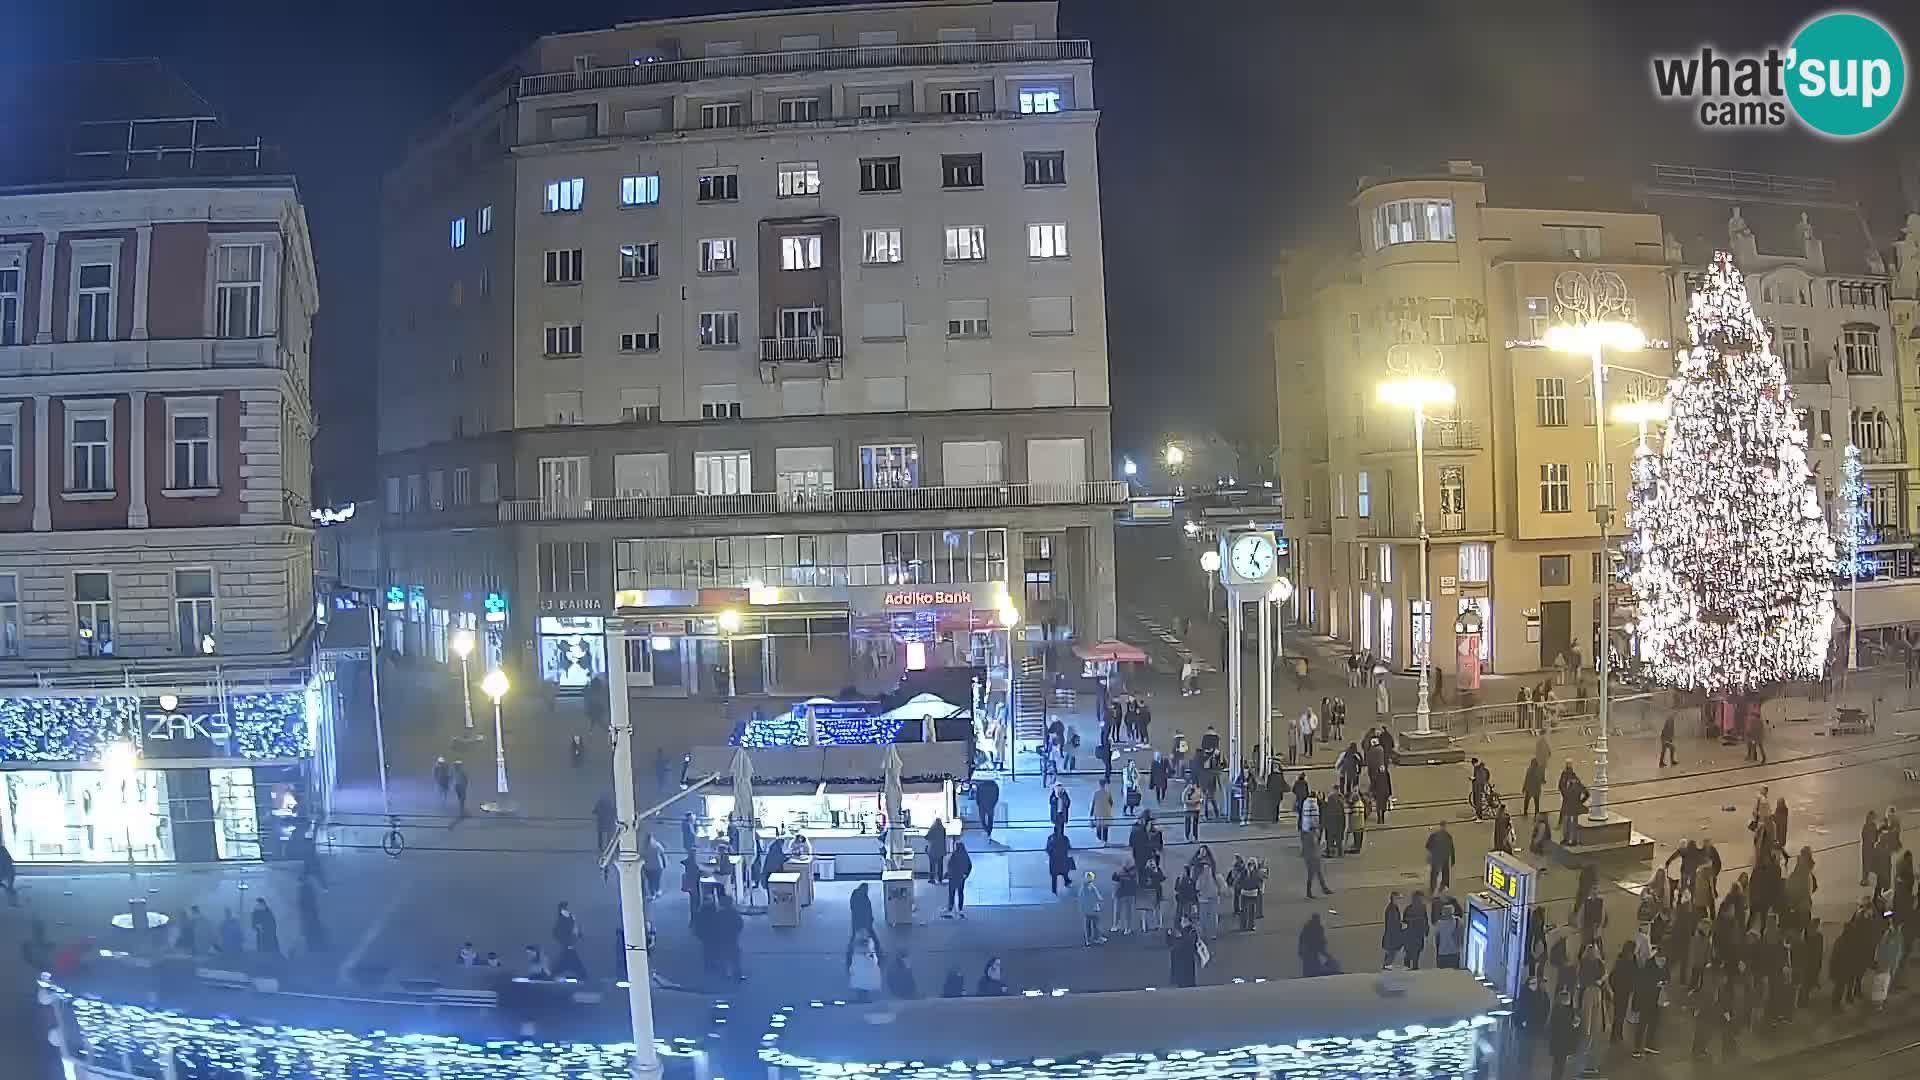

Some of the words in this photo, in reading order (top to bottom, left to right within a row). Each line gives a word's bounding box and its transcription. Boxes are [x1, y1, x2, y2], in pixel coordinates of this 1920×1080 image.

[885, 591, 933, 605] Addiko
[935, 590, 971, 604] Bank
[145, 714, 232, 741] ZAKS
